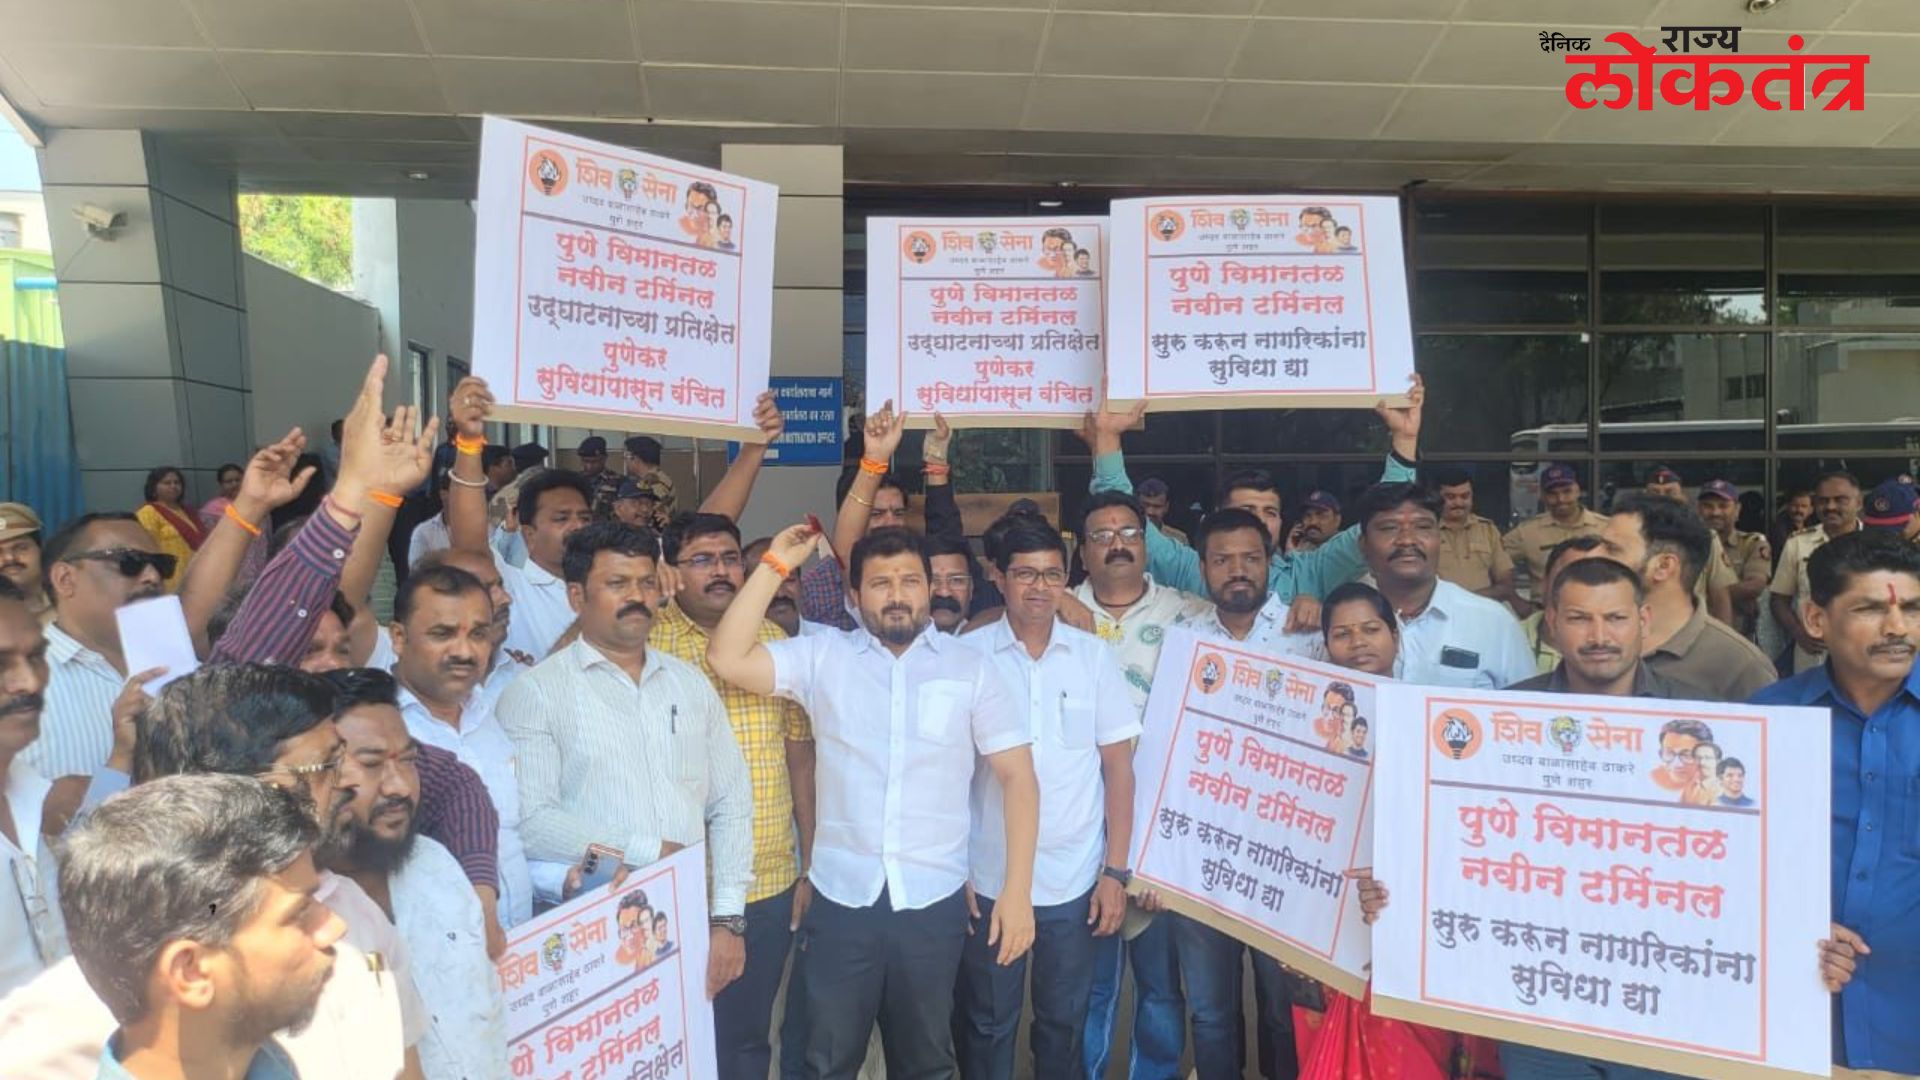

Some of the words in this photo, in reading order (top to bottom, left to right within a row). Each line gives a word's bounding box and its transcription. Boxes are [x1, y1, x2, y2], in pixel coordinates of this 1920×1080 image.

[576, 157, 613, 192] शिव
[643, 172, 677, 205] सेना
[1190, 209, 1224, 228] शिव
[1253, 208, 1289, 227] सेना
[556, 231, 597, 262] पुणे
[608, 237, 717, 278] विमानतळ
[942, 231, 974, 252] शिव
[1000, 230, 1033, 251] सेना
[558, 265, 627, 294] नवीन
[635, 275, 715, 309] टर्मिनल
[930, 282, 965, 307] पुणे
[973, 283, 1078, 303] विमानतळ
[1170, 261, 1210, 292] पुणे
[1221, 262, 1344, 285] विमानतळ
[931, 306, 992, 325] नवीन
[1001, 305, 1077, 326] टर्मिनल
[1172, 292, 1243, 316] नवीन
[1253, 290, 1344, 315] टर्मिनल
[664, 311, 735, 344] प्रतिक्षेत
[1031, 328, 1100, 353] प्रतिक्षेत
[1194, 333, 1246, 353] करून
[1254, 326, 1366, 350] नागरिकांना
[603, 337, 667, 372] पुणेकर
[975, 355, 1034, 383] पुणेकर
[1209, 355, 1275, 384] सुविधा
[1284, 358, 1308, 377] द्या
[671, 376, 725, 408] वंचित
[1040, 380, 1093, 404] वंचित
[1232, 660, 1262, 688] शिव
[1285, 672, 1317, 704] सेना
[1490, 711, 1542, 745] शिव
[1586, 717, 1644, 752] सेना
[1195, 729, 1233, 764] पुणे
[1238, 736, 1347, 797] विमानतळ
[1188, 771, 1251, 810] नवीन
[1256, 791, 1336, 843] टर्मिनल
[1459, 798, 1518, 848] पुणे
[1533, 803, 1729, 860] विमानतळ
[1197, 821, 1242, 856] करून
[1247, 840, 1343, 898] नागरिकांना
[1202, 858, 1258, 900] सुविधा
[1261, 884, 1284, 912] द्या
[1460, 852, 1566, 897] नवीन
[1580, 864, 1725, 919] टर्मिनल
[497, 951, 538, 993] शिव
[569, 916, 607, 951] सेना
[1432, 908, 1480, 949] सुरु
[1490, 918, 1569, 954] करून
[1579, 930, 1756, 984] नागरिकांना
[1511, 960, 1610, 1006] सुविधा
[1622, 981, 1661, 1016] द्या
[510, 1043, 534, 1077] णे
[545, 978, 659, 1064] विमानतळ
